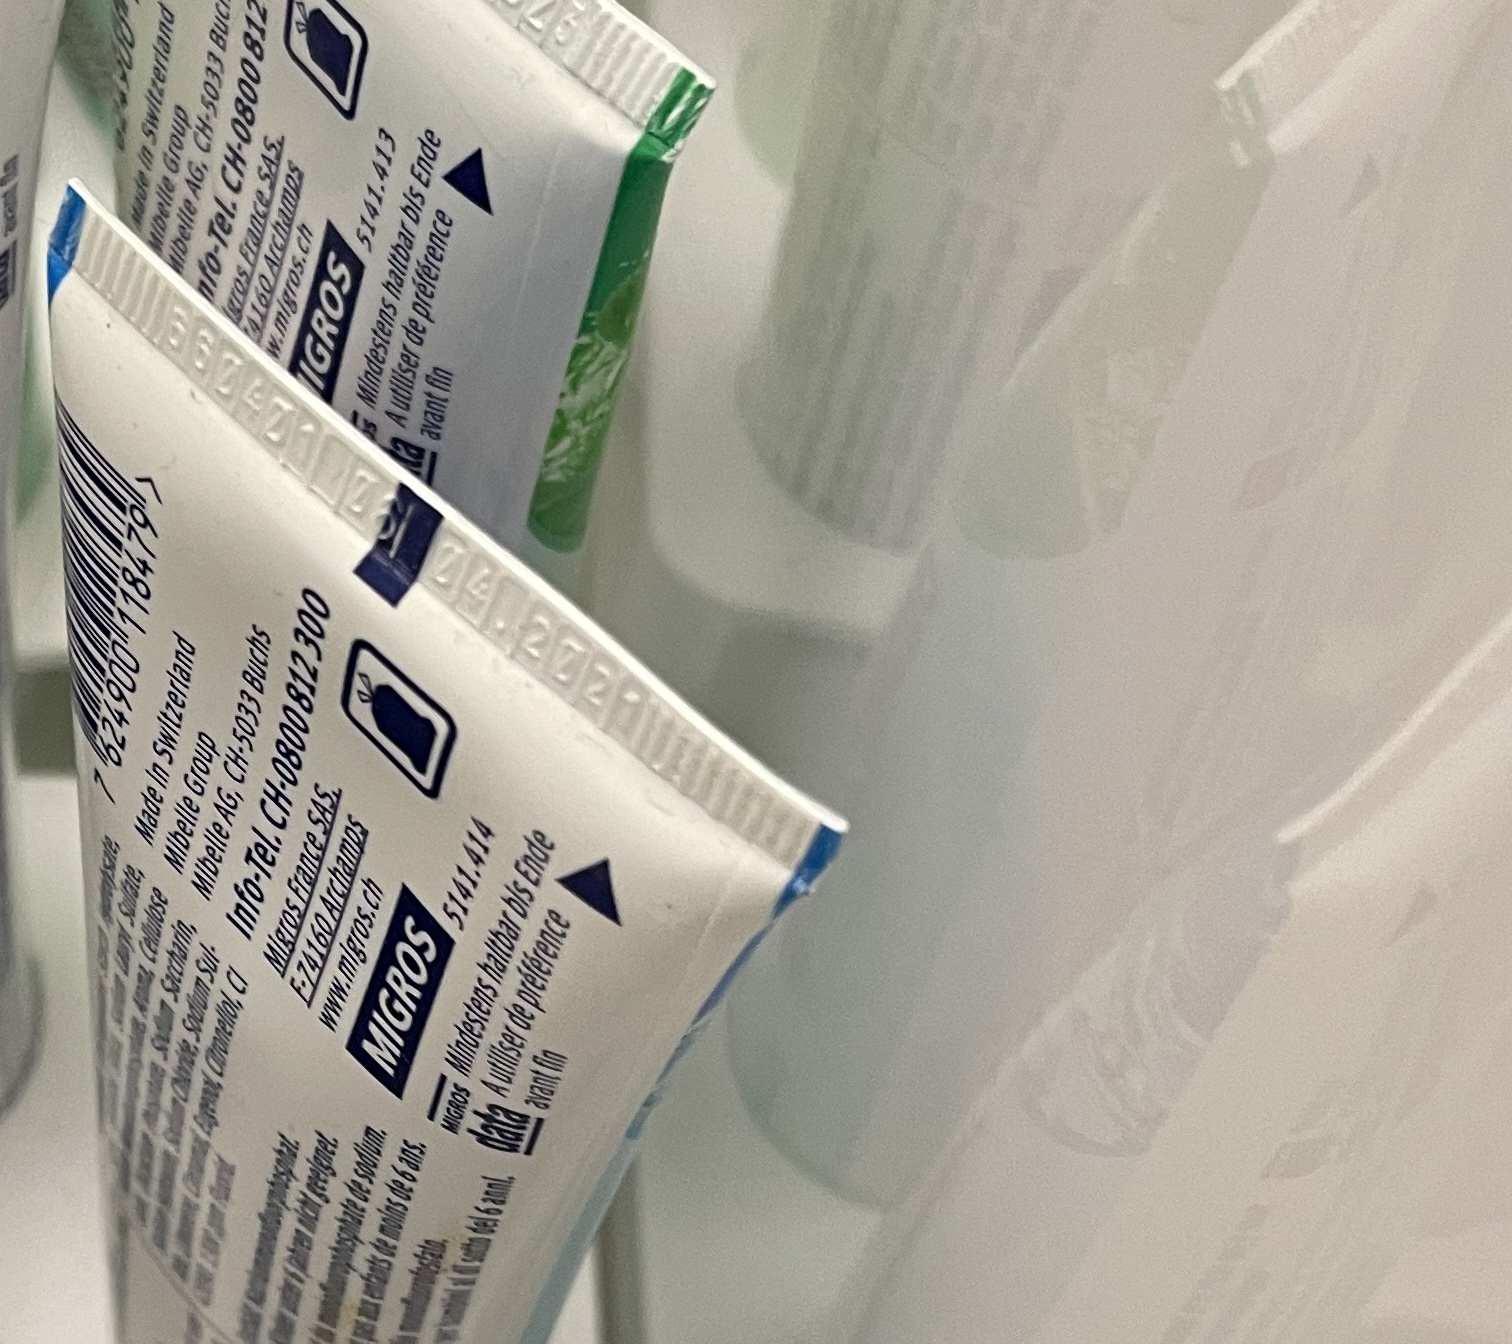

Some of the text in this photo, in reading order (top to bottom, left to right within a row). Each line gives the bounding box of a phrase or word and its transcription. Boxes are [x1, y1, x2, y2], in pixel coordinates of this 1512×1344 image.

[137, 1, 175, 172] in Switzerland
[193, 50, 225, 153] CH-5033
[220, 57, 261, 195] CH-0800
[147, 104, 192, 257] Mibelle Group
[184, 160, 209, 201] AG,
[238, 188, 273, 270] France
[263, 159, 305, 277] Archamps
[356, 127, 396, 253] 5141.413
[355, 128, 442, 411] Mindestens haltbar bis Ende
[384, 208, 453, 429] A utiliser de préférence
[419, 366, 454, 441] avant fin
[92, 498, 160, 805] 7 624900 118479
[134, 630, 196, 847] Made in Switzerland
[190, 623, 272, 902] Mibelle AG, CH-5033 Buchs
[225, 587, 331, 941] Info-Tel. CH-0800 812 300
[163, 731, 221, 876] Mibelle Group
[138, 886, 169, 965] Cellulose
[262, 831, 328, 978] Migros France
[289, 813, 370, 1009] F-74160 Archamps
[442, 816, 494, 932] 5141.414
[160, 919, 198, 1004] Saccharin,
[181, 942, 221, 1043] Sodium Sul-
[318, 877, 384, 1033] www.migros.ch
[362, 915, 437, 1077] MIGROS
[444, 829, 555, 1078] Mindestens haltbar bis Ende
[479, 909, 571, 1099] A utiliser de préférence
[440, 1082, 471, 1136] MIGROS
[466, 1103, 531, 1154] data
[524, 1049, 568, 1110] avant fin
[301, 1129, 339, 1205] geeignet.
[344, 1125, 388, 1204] de sodium.
[386, 1179, 414, 1202] de
[391, 1164, 418, 1183] 6
[398, 1138, 427, 1172] ans.
